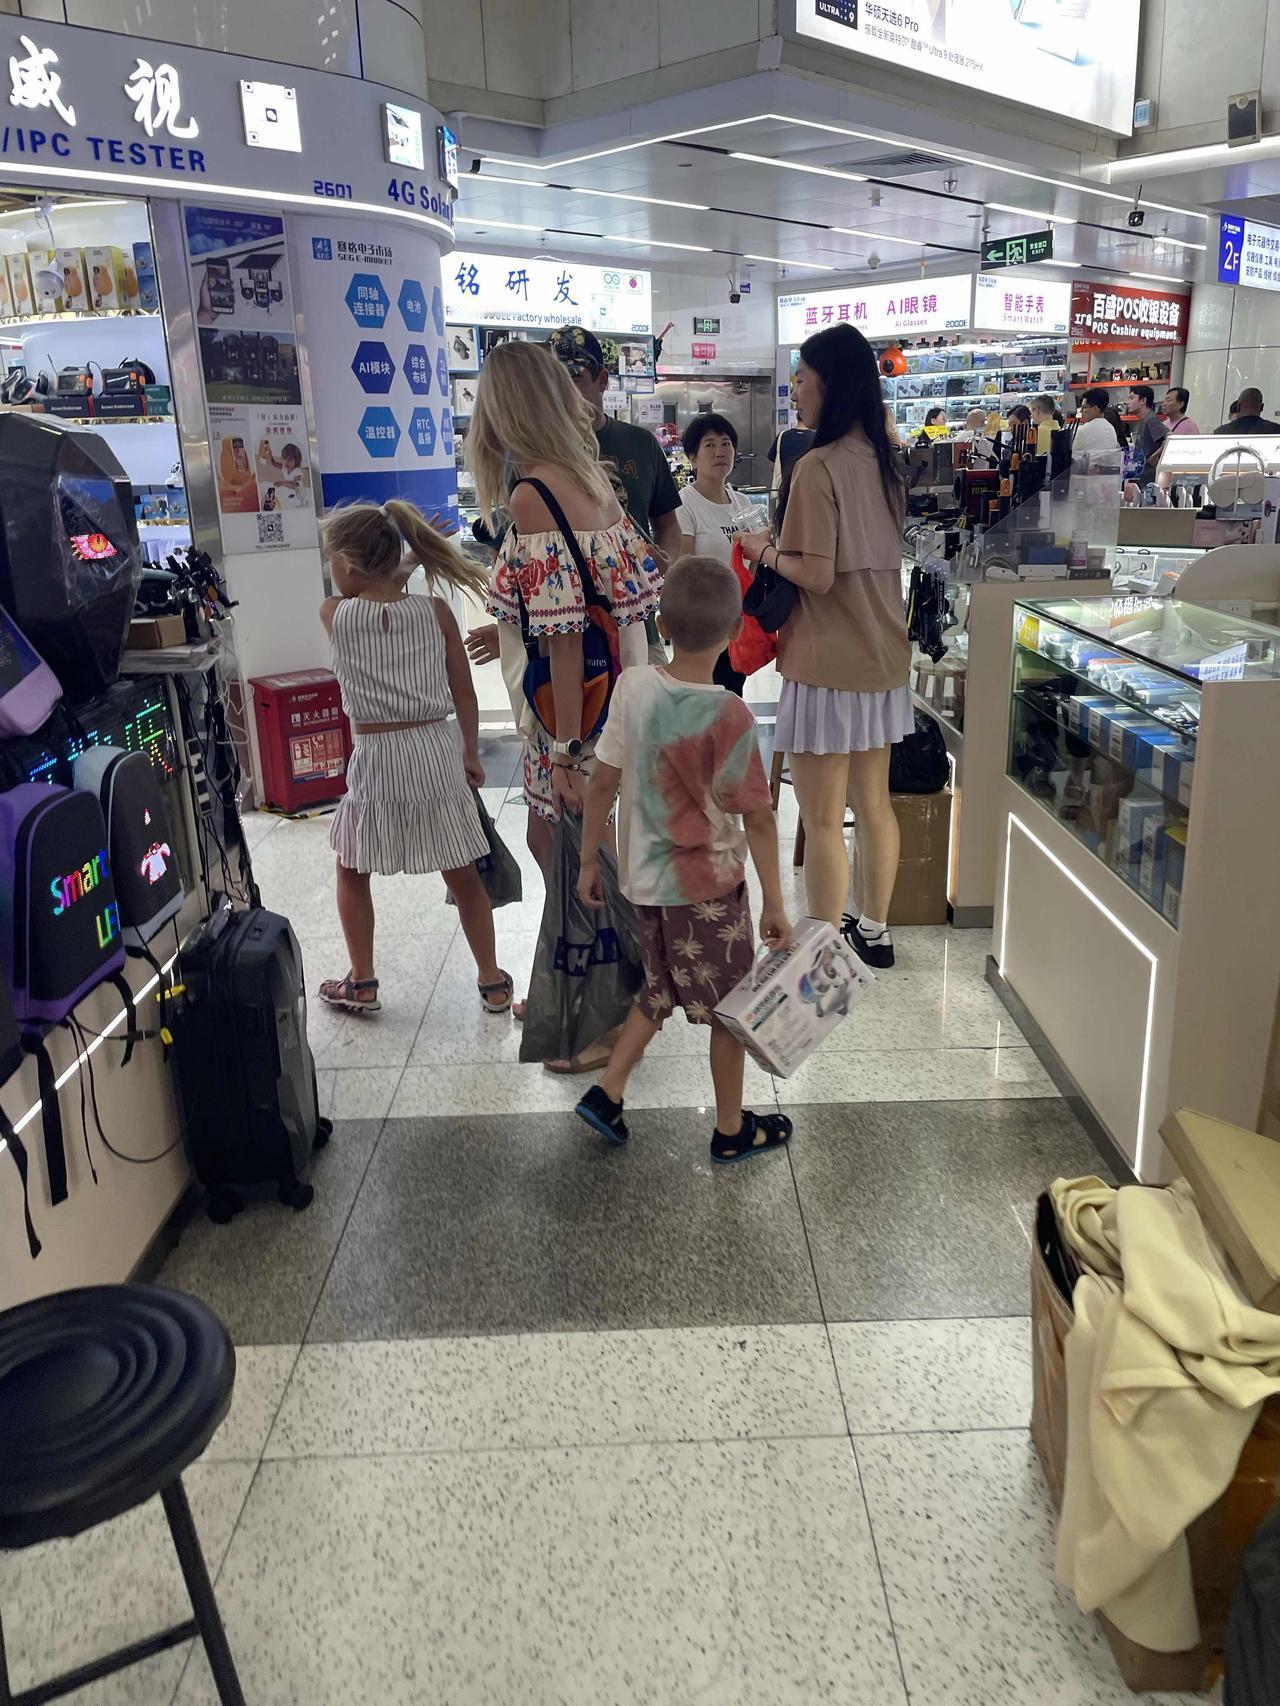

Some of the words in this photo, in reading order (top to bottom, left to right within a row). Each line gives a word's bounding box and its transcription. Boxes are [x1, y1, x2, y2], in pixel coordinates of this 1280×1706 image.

[819, 2, 840, 17] ULTRA
[848, 12, 855, 23] 9
[864, 1, 903, 27] 华硕天选6
[904, 15, 919, 33] Pro
[9, 34, 199, 139] 威视
[86, 135, 207, 173] TESTER
[313, 179, 354, 200] 2601
[388, 178, 416, 206] 4G
[337, 241, 393, 258] 赛格电子市场
[1223, 240, 1240, 271] 2F
[357, 286, 379, 301] 同轴
[1004, 293, 1044, 313] 智能手表
[353, 302, 385, 318] 连接器
[406, 298, 422, 314] 电池
[806, 302, 868, 325] 蓝牙耳机
[886, 294, 938, 316] AI眼镜
[1093, 292, 1180, 327] 百盛POS收银设备
[543, 313, 582, 325] wholesale
[902, 319, 928, 328] Glasses
[1092, 321, 1108, 335] POS
[1110, 323, 1139, 337] Cashier
[1140, 328, 1177, 340] equipment
[359, 361, 391, 376] AI模块
[411, 355, 426, 369] 综合
[364, 425, 396, 440] 温控器
[416, 418, 431, 430] RTC
[50, 848, 109, 916] Smart
